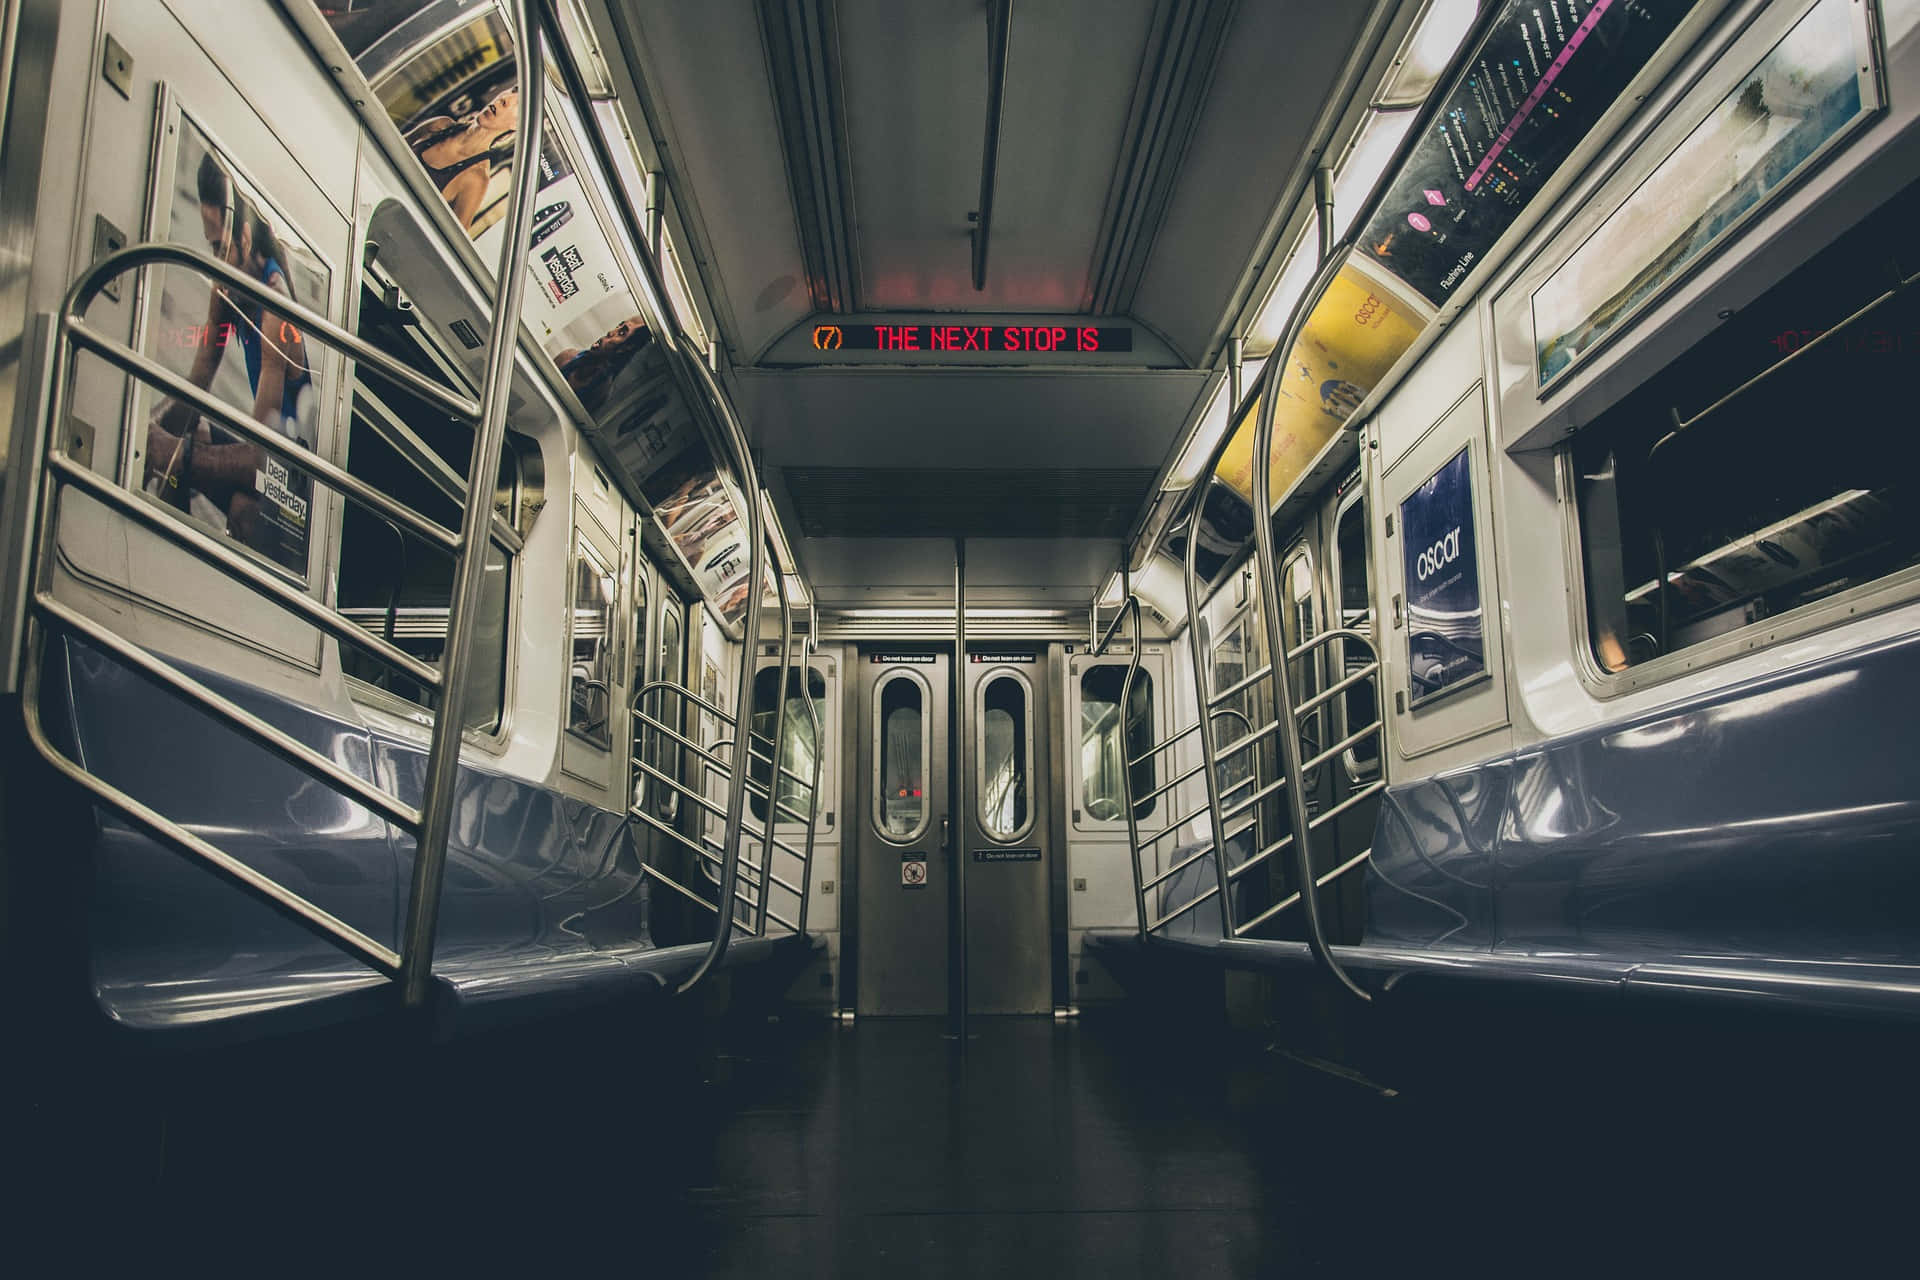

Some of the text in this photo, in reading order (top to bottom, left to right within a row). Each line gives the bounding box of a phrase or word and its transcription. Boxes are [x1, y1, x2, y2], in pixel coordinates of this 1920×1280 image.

[562, 246, 581, 270] beat
[1440, 264, 1466, 290] Flushing
[1458, 251, 1474, 268] Line
[813, 325, 1099, 351] (7) THE NEXT STOP IS
[267, 459, 288, 486] beat
[1417, 526, 1460, 581] oscar
